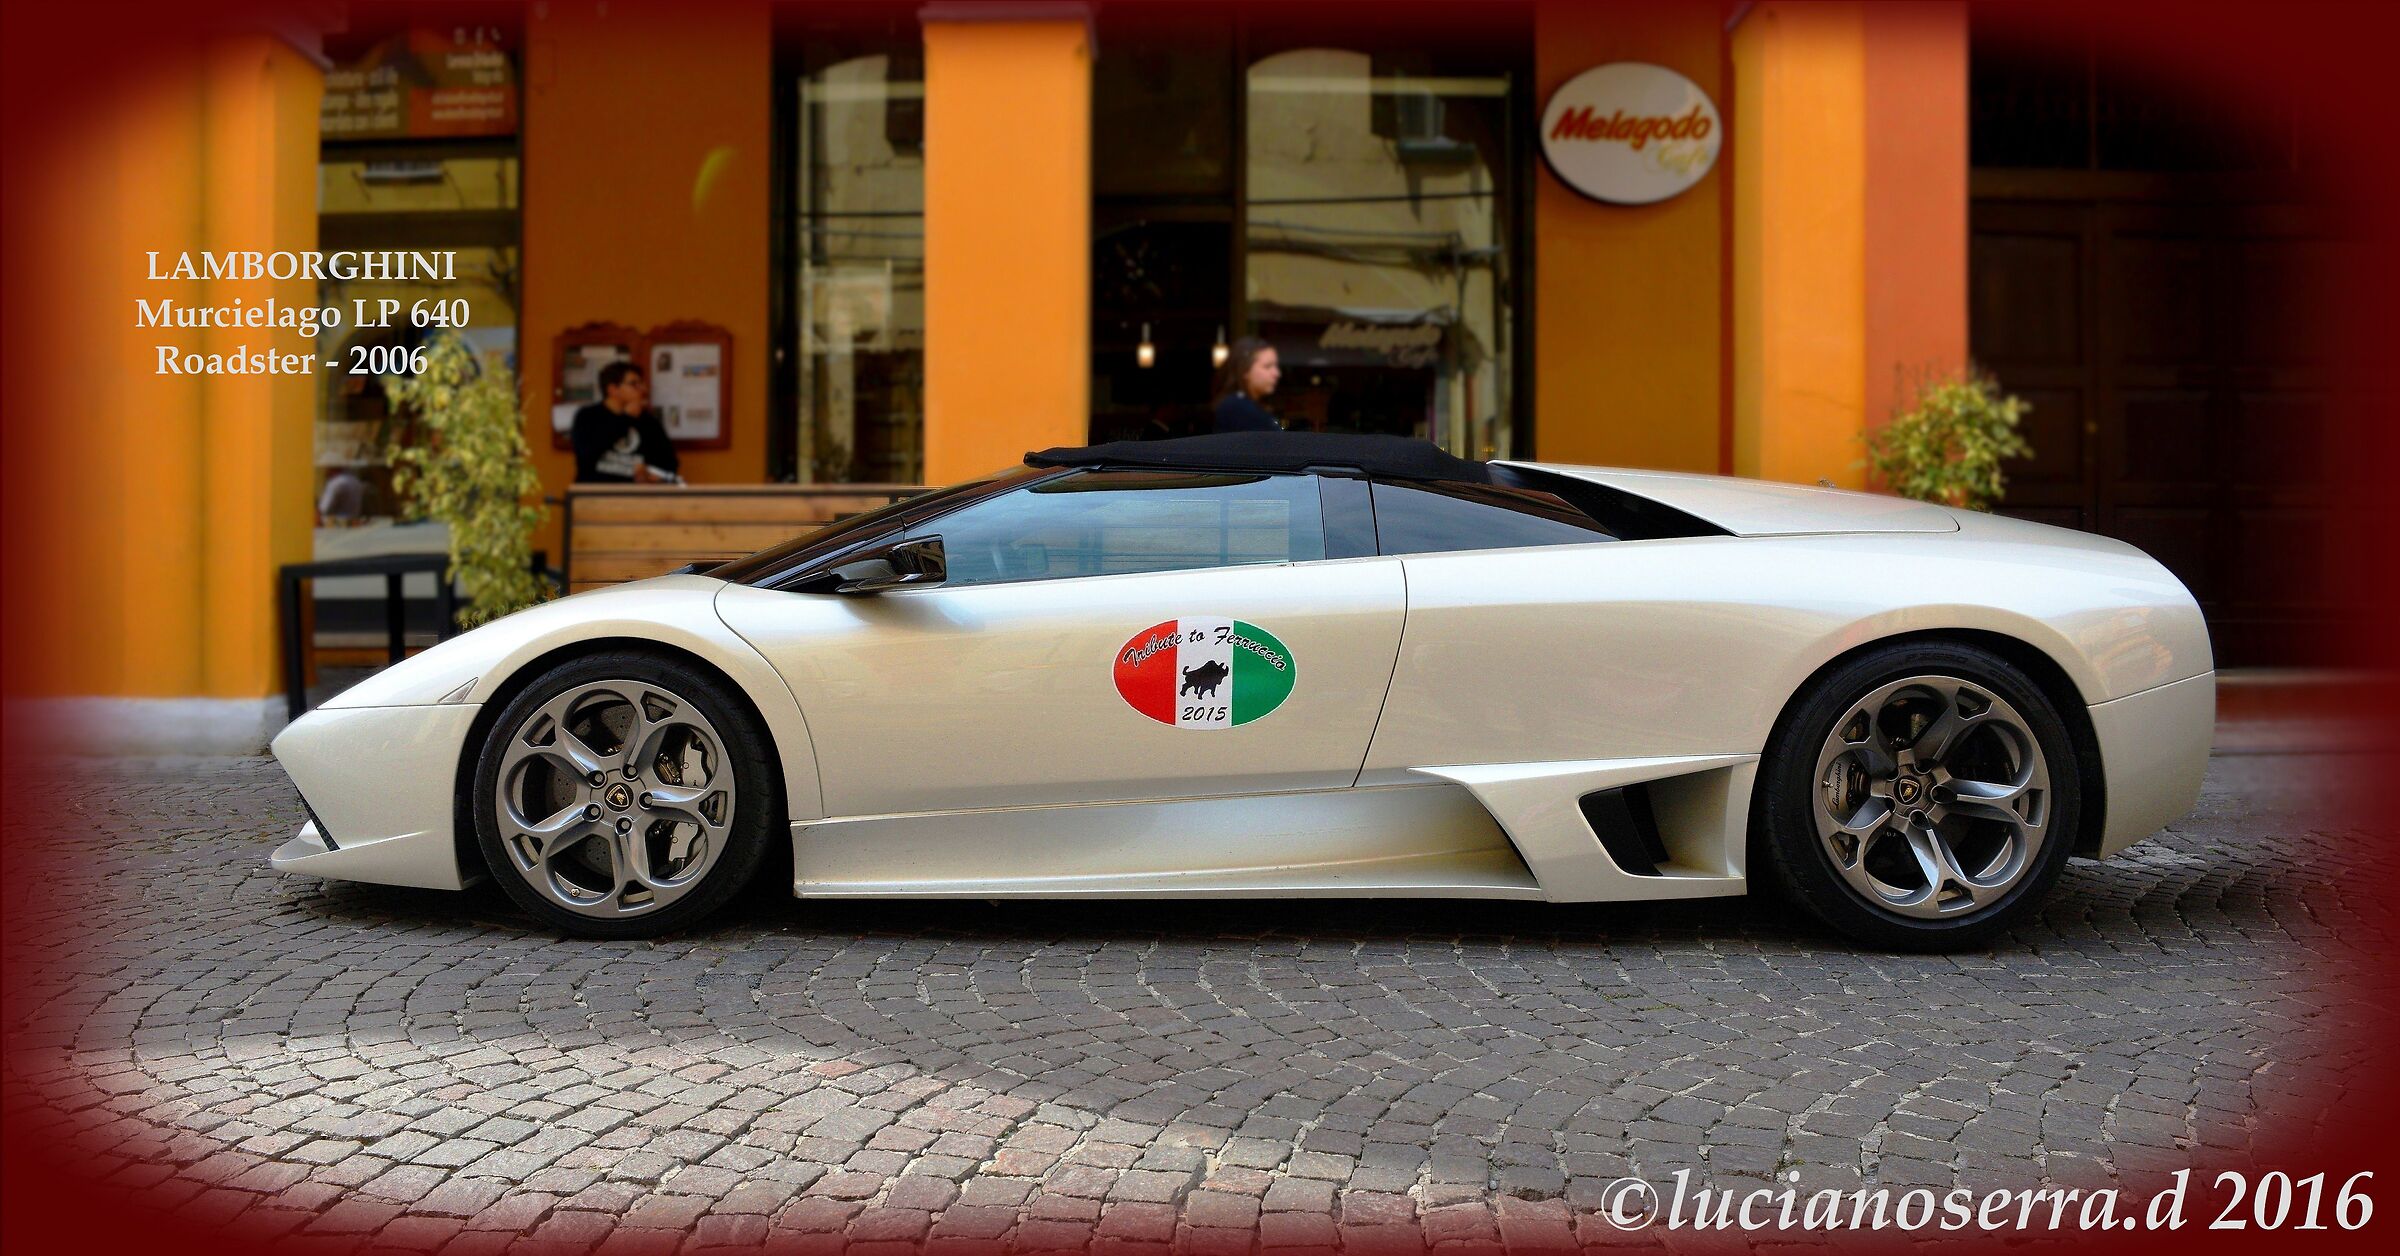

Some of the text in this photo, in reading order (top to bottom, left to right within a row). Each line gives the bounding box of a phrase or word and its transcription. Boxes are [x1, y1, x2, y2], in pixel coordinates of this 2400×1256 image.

[1551, 104, 1711, 152] Melagodo
[1123, 626, 1287, 672] Tribute to Ferruccio
[1182, 706, 1228, 722] 2015
